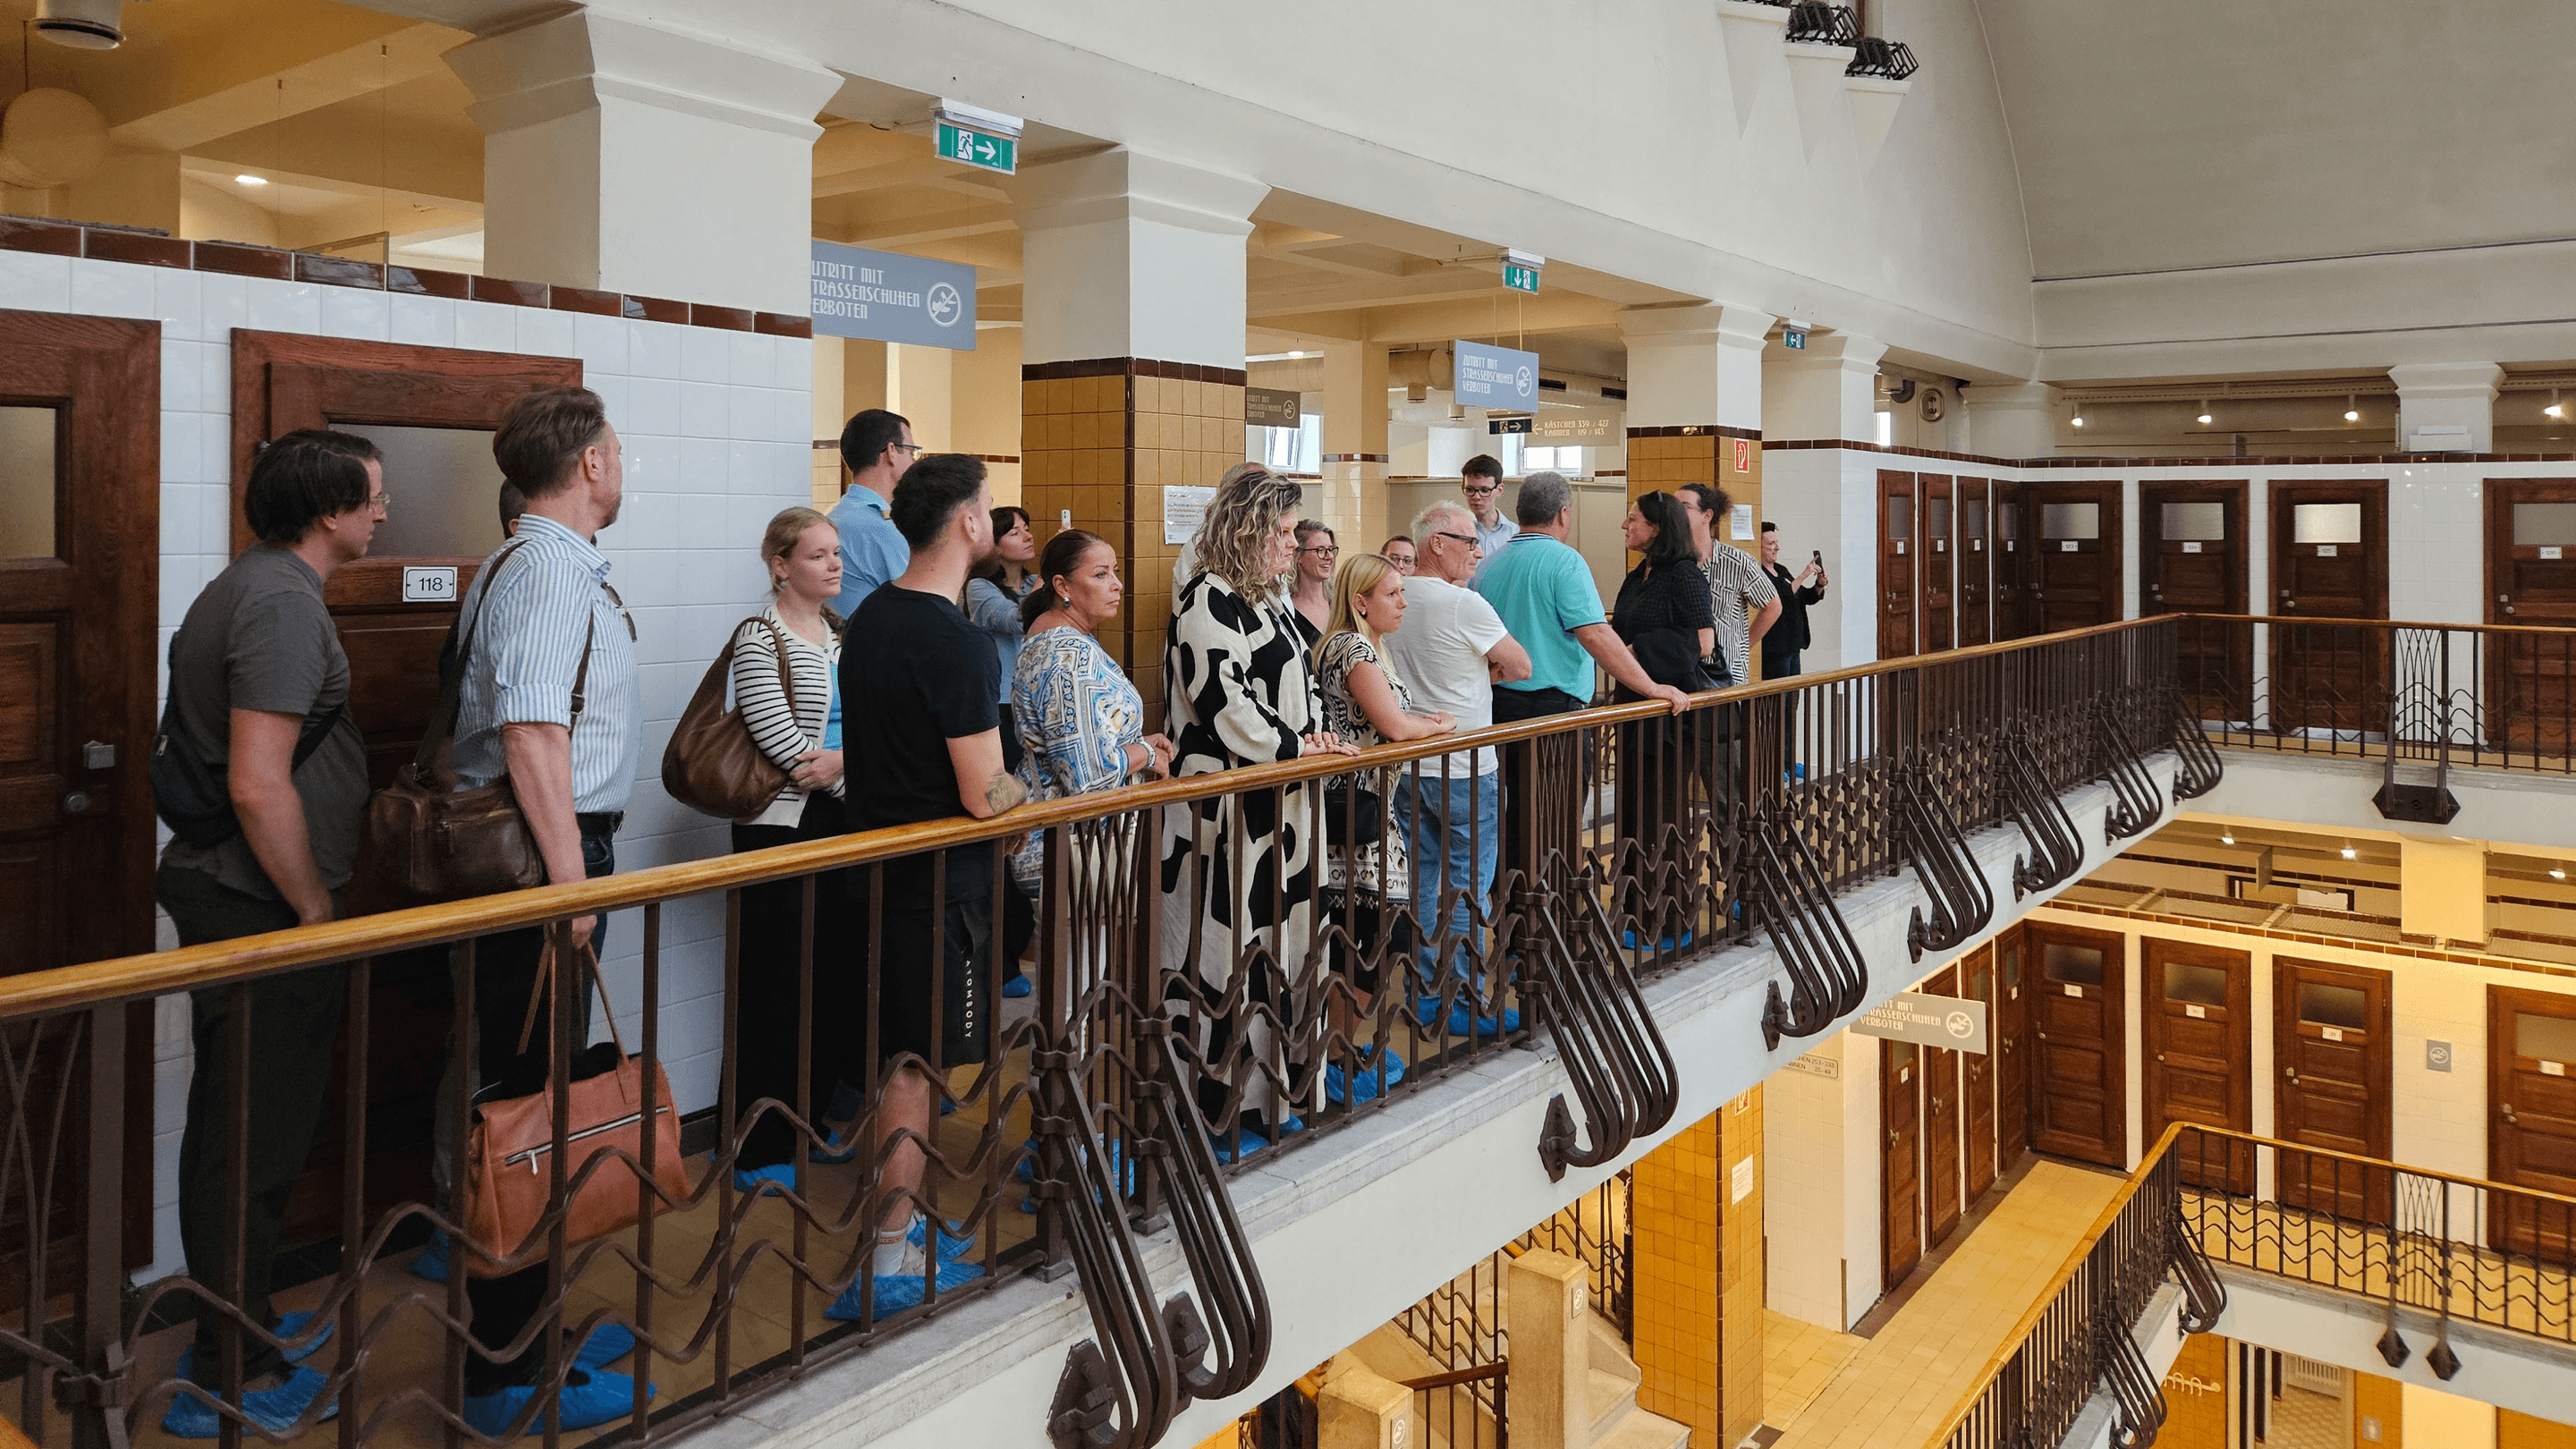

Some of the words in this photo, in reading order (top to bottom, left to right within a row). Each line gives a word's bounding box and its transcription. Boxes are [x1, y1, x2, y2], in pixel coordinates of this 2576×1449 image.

[811, 260, 855, 281] UTRITT
[860, 267, 885, 285] MIT
[811, 278, 920, 309] TRASSENSCHUHEN
[811, 297, 868, 319] ERBOTEN
[1462, 354, 1486, 369] ZUTRITT
[1487, 358, 1498, 370] MIT
[1462, 380, 1491, 394] VERBOTEN
[419, 577, 443, 591] 118
[1897, 1001, 1914, 1013] MIT
[1860, 1015, 1903, 1031] VERBOTEN
[1867, 1007, 1941, 1026] RASSENSCHUHEN
